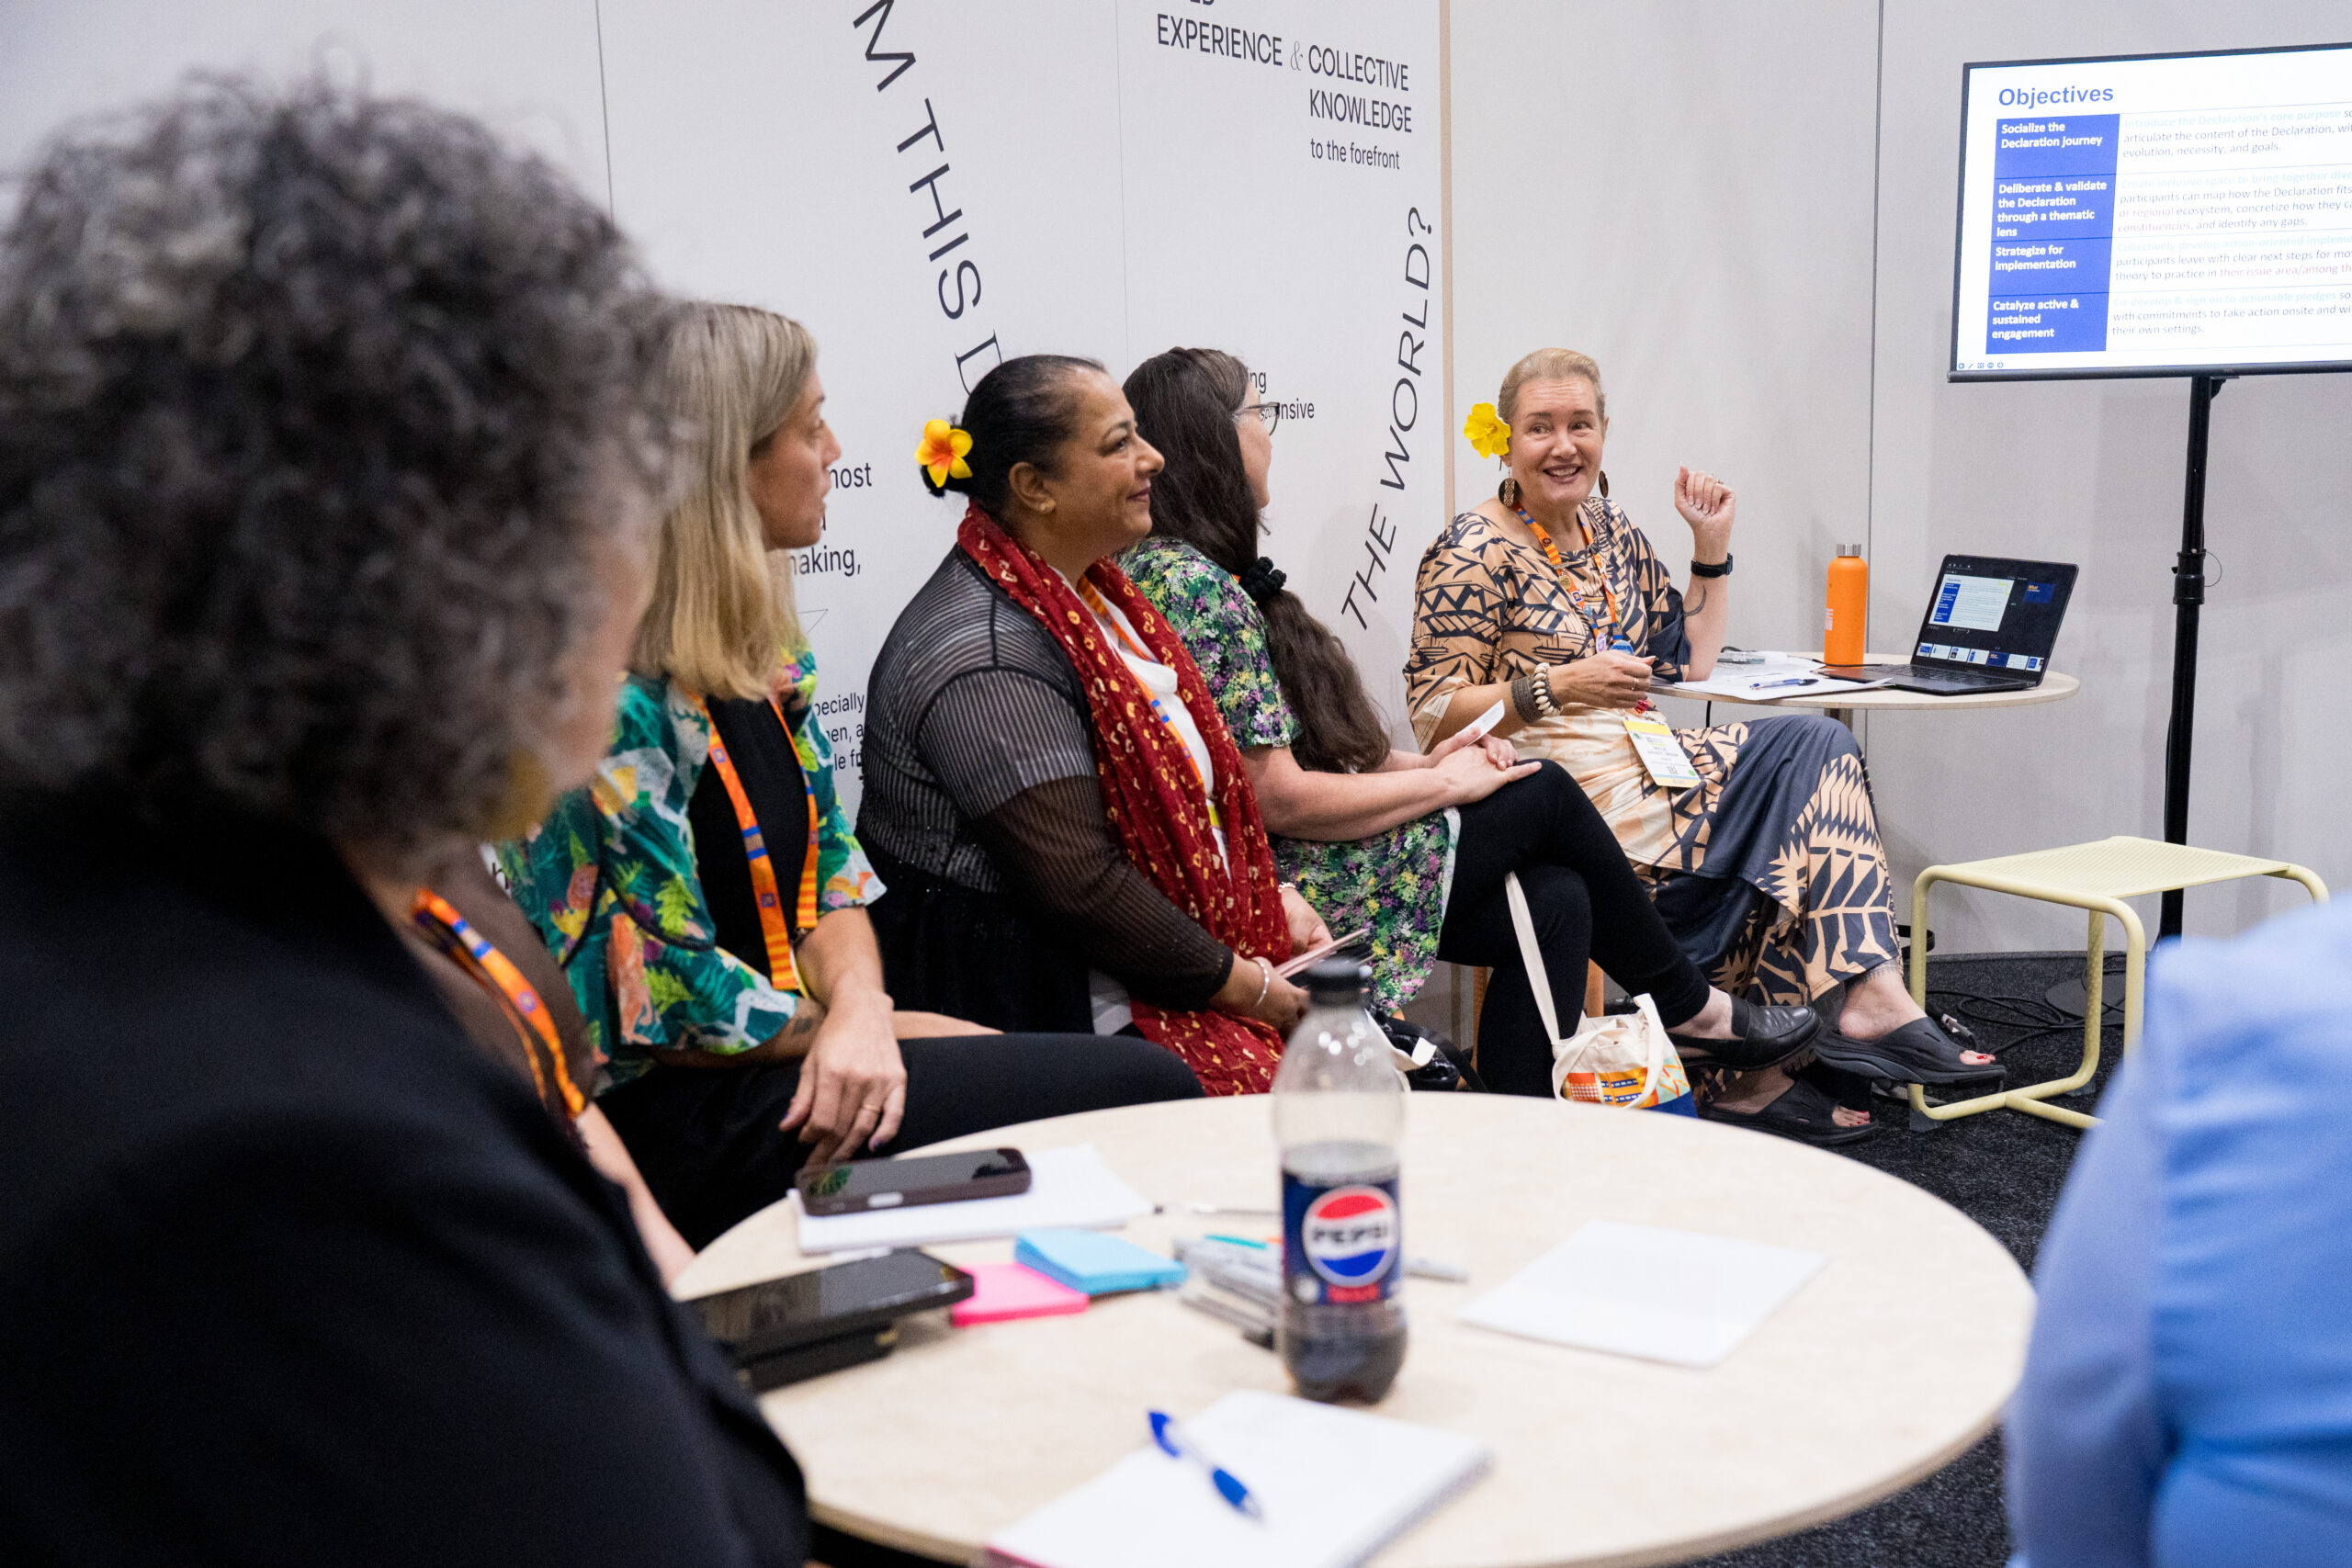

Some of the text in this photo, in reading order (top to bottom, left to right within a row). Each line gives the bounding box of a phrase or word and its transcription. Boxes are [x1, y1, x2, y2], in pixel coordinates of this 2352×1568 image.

[1157, 13, 1409, 92] EXPERIENCE & COLLECTIVE
[1998, 85, 2114, 109] Objectives
[1309, 89, 1412, 133] KNOWLEDGE
[2125, 118, 2176, 128] Introduce
[2297, 110, 2341, 122] purpose
[2001, 122, 2065, 134] Socialize the
[2124, 131, 2172, 142] articulate
[2175, 130, 2192, 141] the
[2195, 130, 2234, 140] content
[2238, 128, 2248, 138] of
[2251, 127, 2268, 137] the
[2272, 124, 2335, 137] Declaration,
[2001, 136, 2102, 149] Declaration journey
[2122, 141, 2281, 158] evolution, necessity, and goals.
[1310, 138, 1400, 170] to the forefront
[1999, 181, 2107, 194] Deliberate & validate
[2120, 192, 2180, 204] participants
[2203, 191, 2225, 201] map
[2229, 189, 2251, 198] how
[2254, 187, 2271, 197] the
[2274, 186, 2333, 197] Declaration
[897, 97, 981, 320] THIS
[1998, 197, 2075, 209] the Declaration
[2133, 207, 2174, 219] regional
[2177, 206, 2233, 217] ecosystem,
[2236, 202, 2290, 213] concretize
[2292, 201, 2315, 210] how
[2318, 200, 2341, 211] they
[1997, 211, 2038, 223] through
[2049, 209, 2095, 221] thematic
[2197, 220, 2215, 230] and
[2218, 218, 2257, 229] identify
[2260, 219, 2278, 229] any
[2281, 217, 2308, 228] gaps.
[1996, 227, 2018, 237] lens
[1996, 245, 2064, 257] Strategize for
[2116, 250, 2352, 268] participants leave with clear next steps for mo
[1996, 259, 2076, 272] implementation
[2116, 271, 2148, 281] theory
[2152, 271, 2162, 279] to
[2164, 269, 2205, 281] practice
[2208, 268, 2217, 277] in
[2220, 267, 2245, 277] their
[2246, 266, 2272, 276] issue
[2275, 264, 2338, 276] area/among
[1993, 299, 2079, 312] Catalyze active &
[2113, 311, 2135, 321] with
[2138, 310, 2207, 321] commitments
[2210, 310, 2221, 318] to
[2223, 308, 2245, 318] take
[2247, 307, 2279, 317] action
[2282, 306, 2313, 316] onsite
[2316, 304, 2336, 314] and
[1993, 314, 2041, 324] sustained
[1992, 328, 2054, 340] engagement
[2112, 324, 2205, 335] their own settings.
[1341, 207, 1432, 630] THE WORLD?
